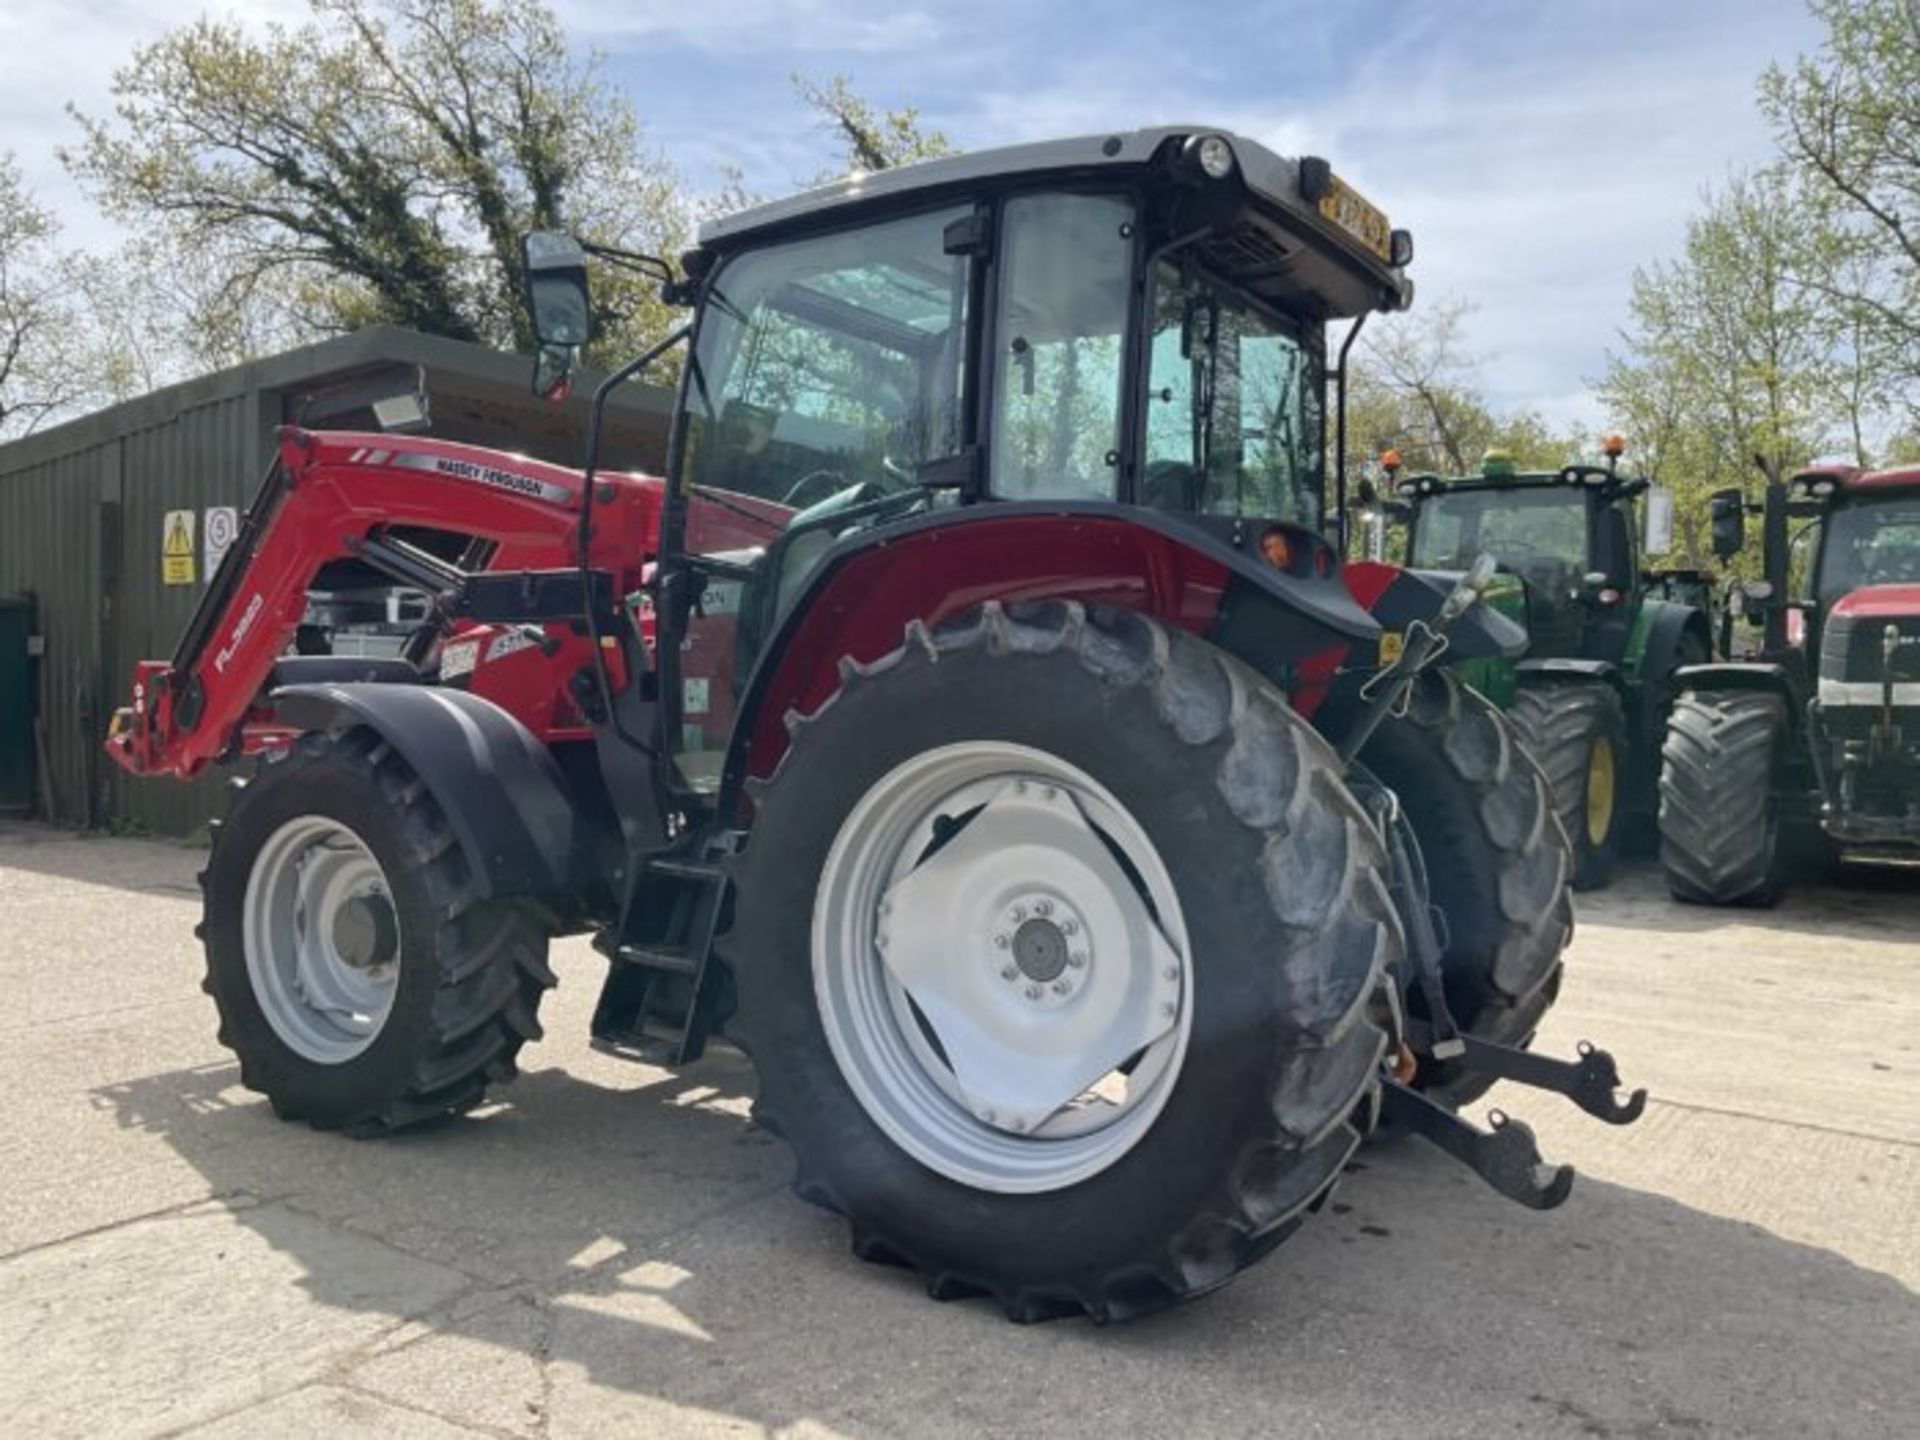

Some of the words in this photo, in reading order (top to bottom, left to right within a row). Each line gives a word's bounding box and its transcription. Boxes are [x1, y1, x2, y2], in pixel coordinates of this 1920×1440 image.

[437, 459, 481, 479] MASSEY
[482, 466, 543, 494] FERGUSON
[216, 518, 226, 540] 5
